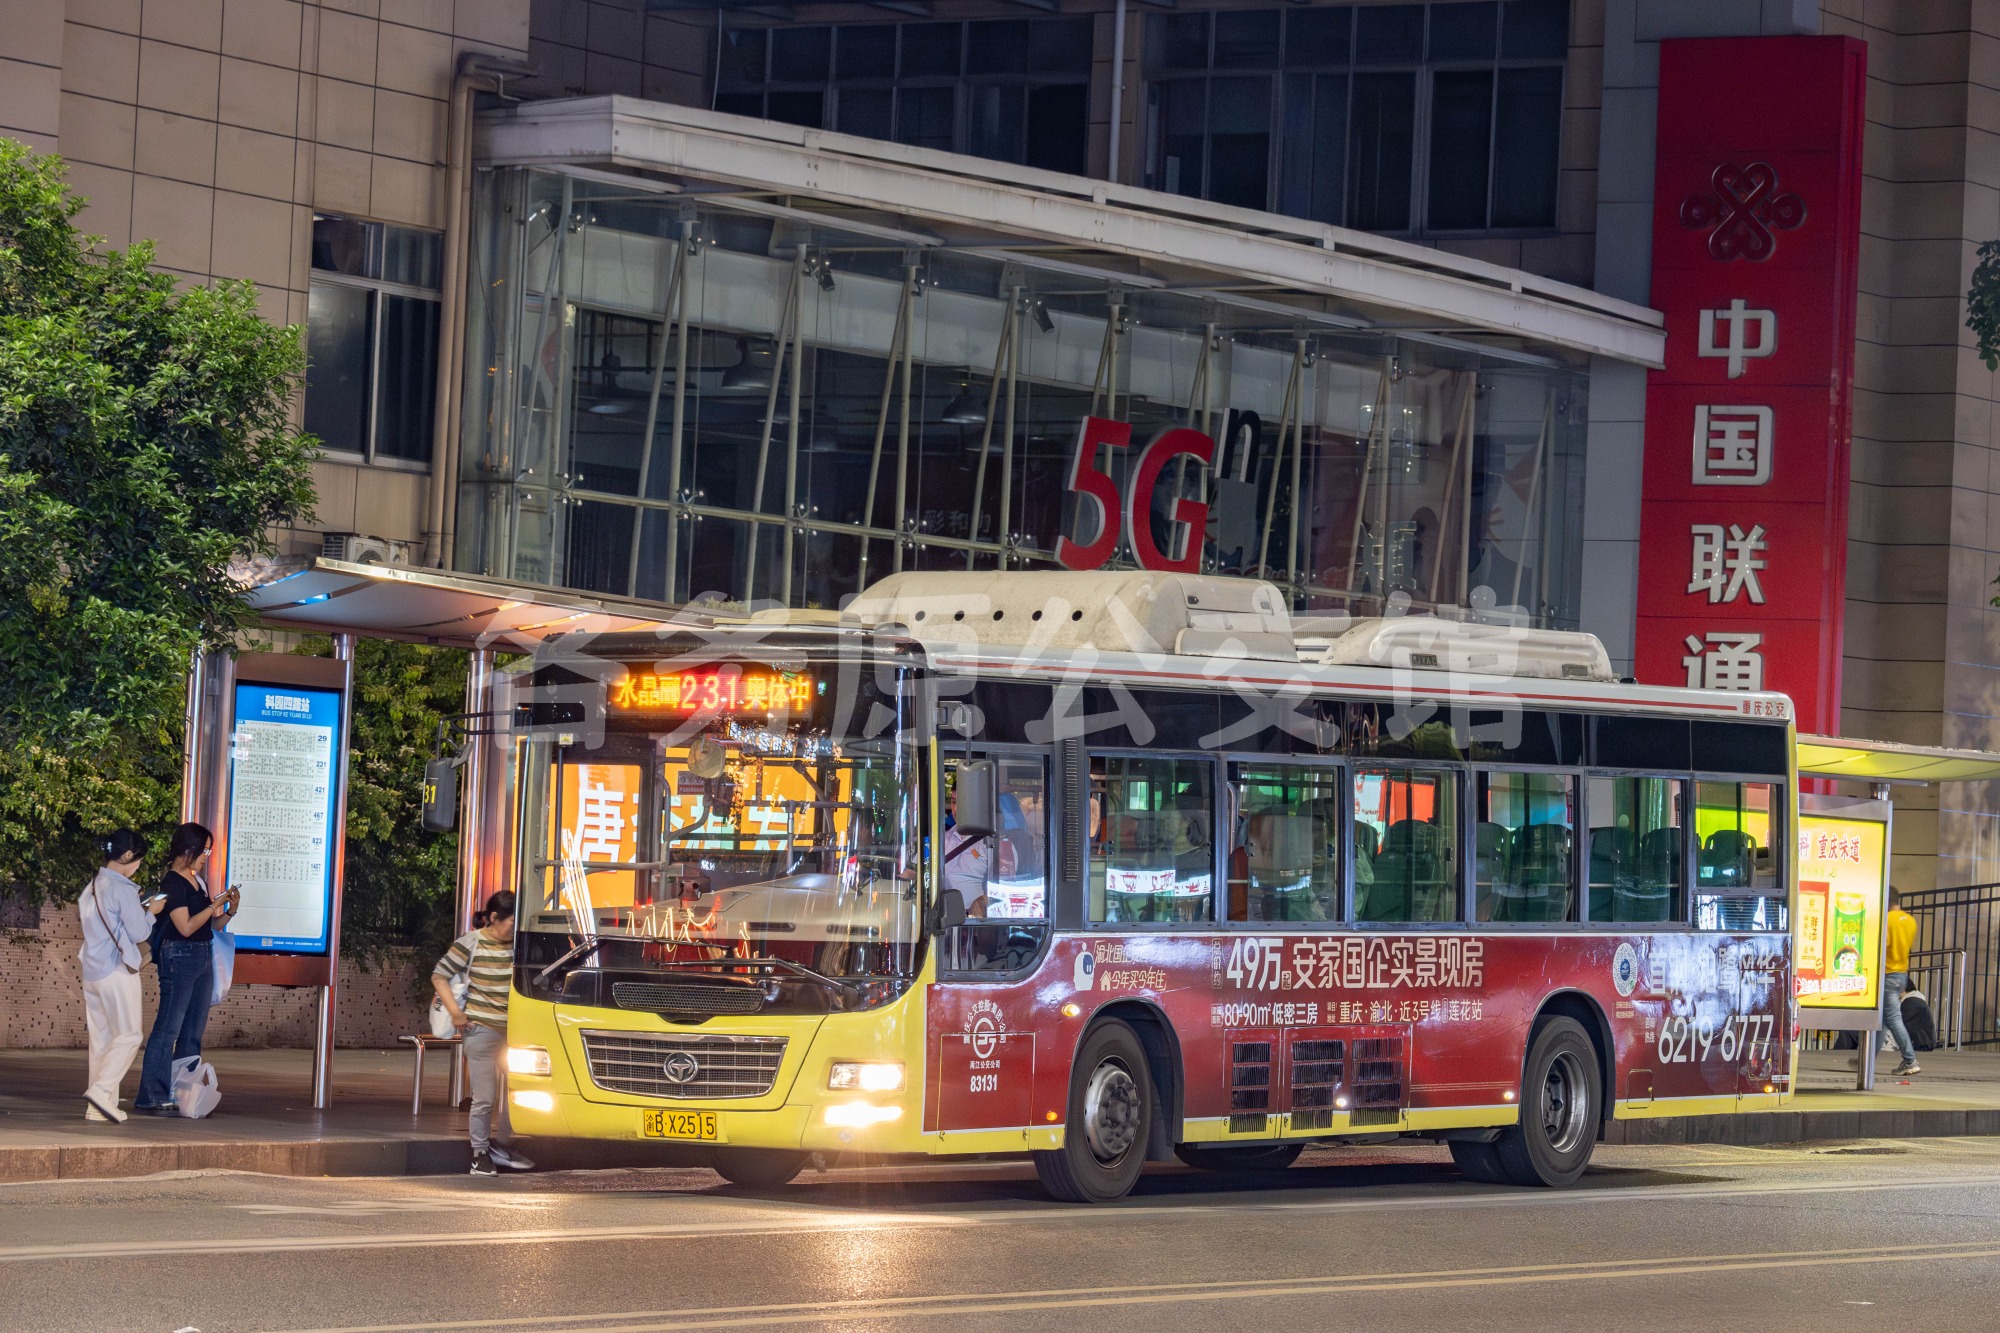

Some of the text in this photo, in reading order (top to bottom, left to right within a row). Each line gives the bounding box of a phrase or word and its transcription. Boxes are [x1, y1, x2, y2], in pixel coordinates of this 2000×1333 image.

[1682, 299, 1778, 690] 中国联通
[681, 675, 737, 709] 231
[744, 677, 811, 711] 奥体中
[1742, 700, 1785, 717] 重庆公交
[316, 760, 327, 768] 231
[1818, 833, 1860, 863] 重庆味道
[1111, 966, 1166, 990] 今年买今年住
[1226, 937, 1283, 992] 49万
[1292, 937, 1484, 989] 安家国企实景现房
[1449, 1000, 1483, 1021] 莲花站
[1658, 1014, 1774, 1064] 6219 6777
[970, 1073, 998, 1093] 83131
